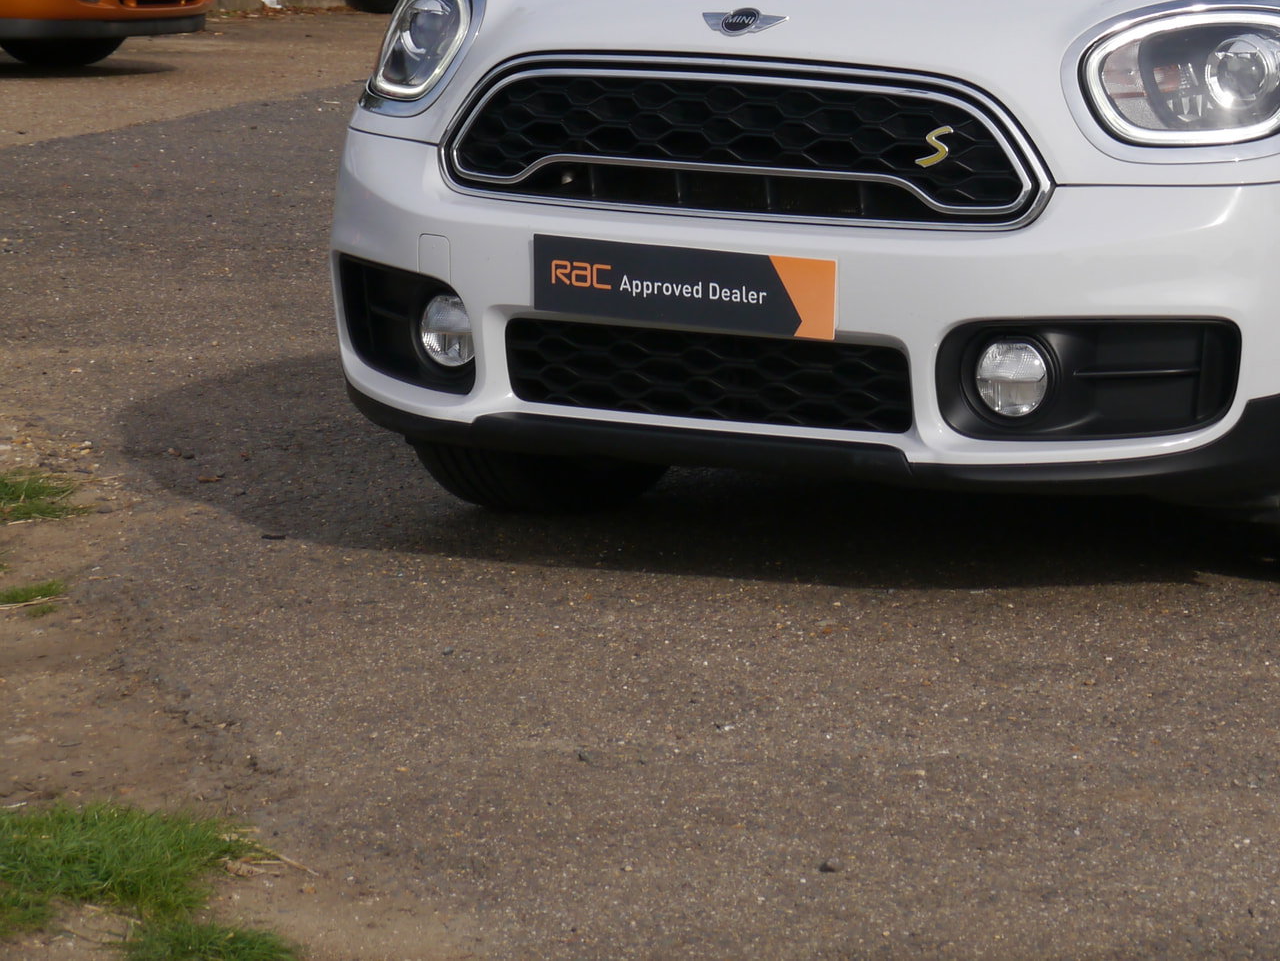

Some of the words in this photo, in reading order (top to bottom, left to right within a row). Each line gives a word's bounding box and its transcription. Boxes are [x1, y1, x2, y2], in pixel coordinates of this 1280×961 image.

[726, 15, 755, 24] MINI
[914, 125, 954, 168] S
[619, 274, 702, 298] Approved
[709, 282, 767, 304] Dealer
